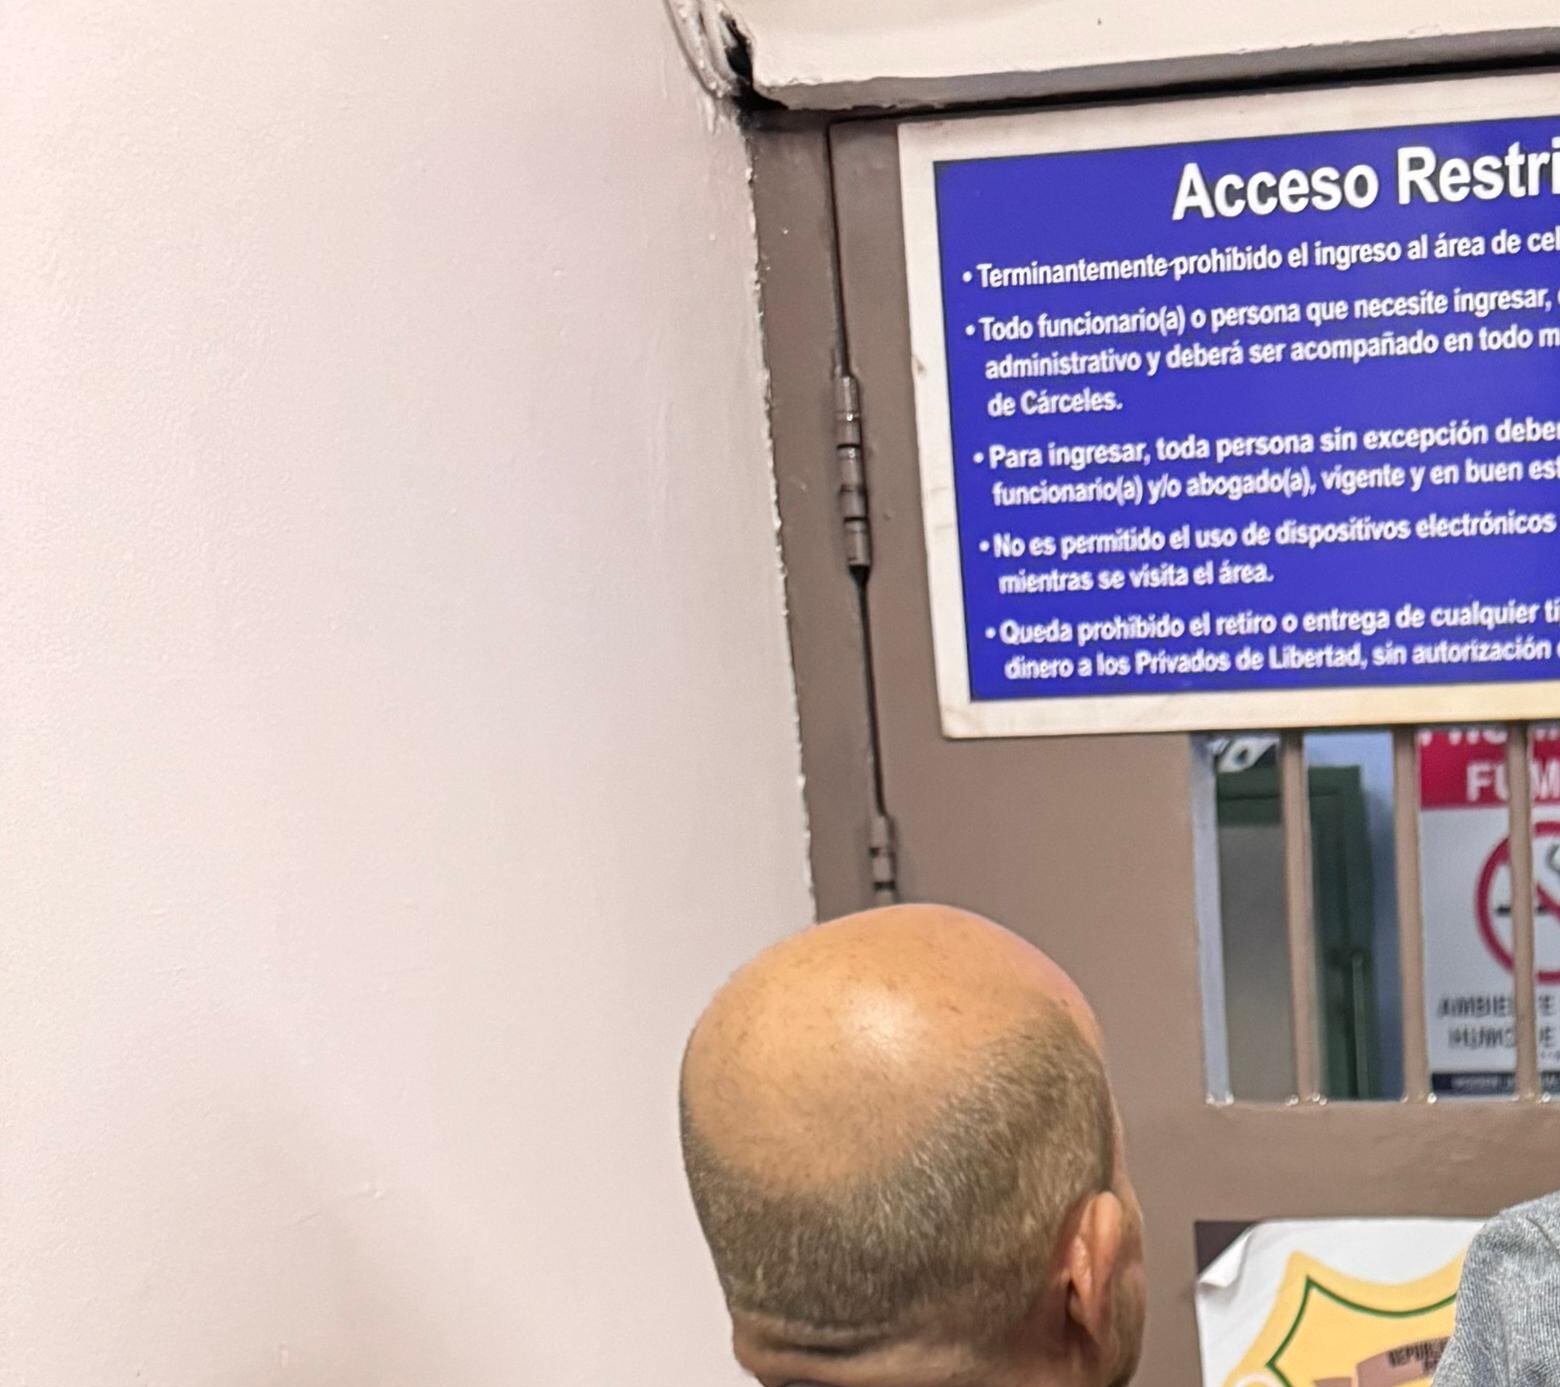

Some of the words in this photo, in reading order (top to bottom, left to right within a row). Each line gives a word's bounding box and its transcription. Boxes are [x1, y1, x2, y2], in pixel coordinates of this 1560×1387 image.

[1171, 162, 1379, 221] Acceso
[975, 253, 1168, 288] Terminantemente
[1172, 244, 1283, 281] prohibido
[1287, 241, 1309, 269] el
[1314, 240, 1403, 271] ingreso
[1406, 233, 1429, 261] al
[1433, 231, 1486, 259] área
[1490, 228, 1522, 255] de
[978, 315, 1034, 342] Todo
[1036, 304, 1186, 338] funcionario(a)
[1190, 308, 1207, 329] o
[1210, 302, 1302, 334] persona
[1305, 299, 1349, 328] que
[1353, 288, 1449, 319] necesite
[1453, 287, 1552, 318] ingresar,
[985, 347, 1143, 380] administrativo
[1145, 350, 1161, 377] y
[1165, 339, 1244, 369] deberá
[1248, 343, 1287, 364] ser
[1290, 328, 1440, 364] acompañado
[1443, 331, 1474, 353] en
[1477, 323, 1534, 352] todo
[987, 392, 1016, 417] de
[1020, 386, 1123, 415] Cárceles.
[988, 444, 1043, 469] Para
[1047, 441, 1151, 471] ingresar,
[1155, 433, 1211, 461] toda
[1215, 433, 1315, 464] persona
[1319, 426, 1358, 453] sin
[1362, 419, 1489, 454] excepción
[991, 474, 1144, 506] funcionario(a)
[1146, 473, 1182, 505] y/o
[1185, 466, 1317, 501] abogado(a),
[1320, 463, 1406, 496] vigente
[1409, 465, 1426, 493] y
[1429, 464, 1460, 485] en
[1464, 457, 1524, 484] buen
[993, 533, 1026, 558] No
[1028, 536, 1057, 557] es
[1060, 526, 1166, 561] permitido
[1168, 524, 1191, 550] el
[1194, 527, 1238, 549] uso
[1241, 521, 1271, 547] de
[1274, 515, 1412, 550] dispositivos
[1414, 509, 1557, 539] electrónicos
[998, 569, 1094, 594] mientras
[1097, 569, 1126, 590] se
[1128, 562, 1189, 588] visita
[1192, 560, 1214, 586] el
[1218, 559, 1274, 585] área.
[999, 618, 1073, 646] Queda
[1077, 613, 1186, 647] prohibido
[1188, 611, 1211, 637] el
[1215, 610, 1278, 636] retiro
[1281, 613, 1299, 634] o
[1302, 607, 1391, 636] entrega
[1394, 603, 1426, 629] de
[1429, 599, 1541, 631] cualquier
[1004, 655, 1075, 680] dinero
[1077, 657, 1093, 677] a
[1096, 652, 1131, 676] los
[1134, 648, 1232, 675] Privados
[1234, 646, 1265, 671] de
[1268, 642, 1368, 670] Libertad,
[1371, 640, 1408, 667] sin
[1411, 635, 1552, 665] autorización
